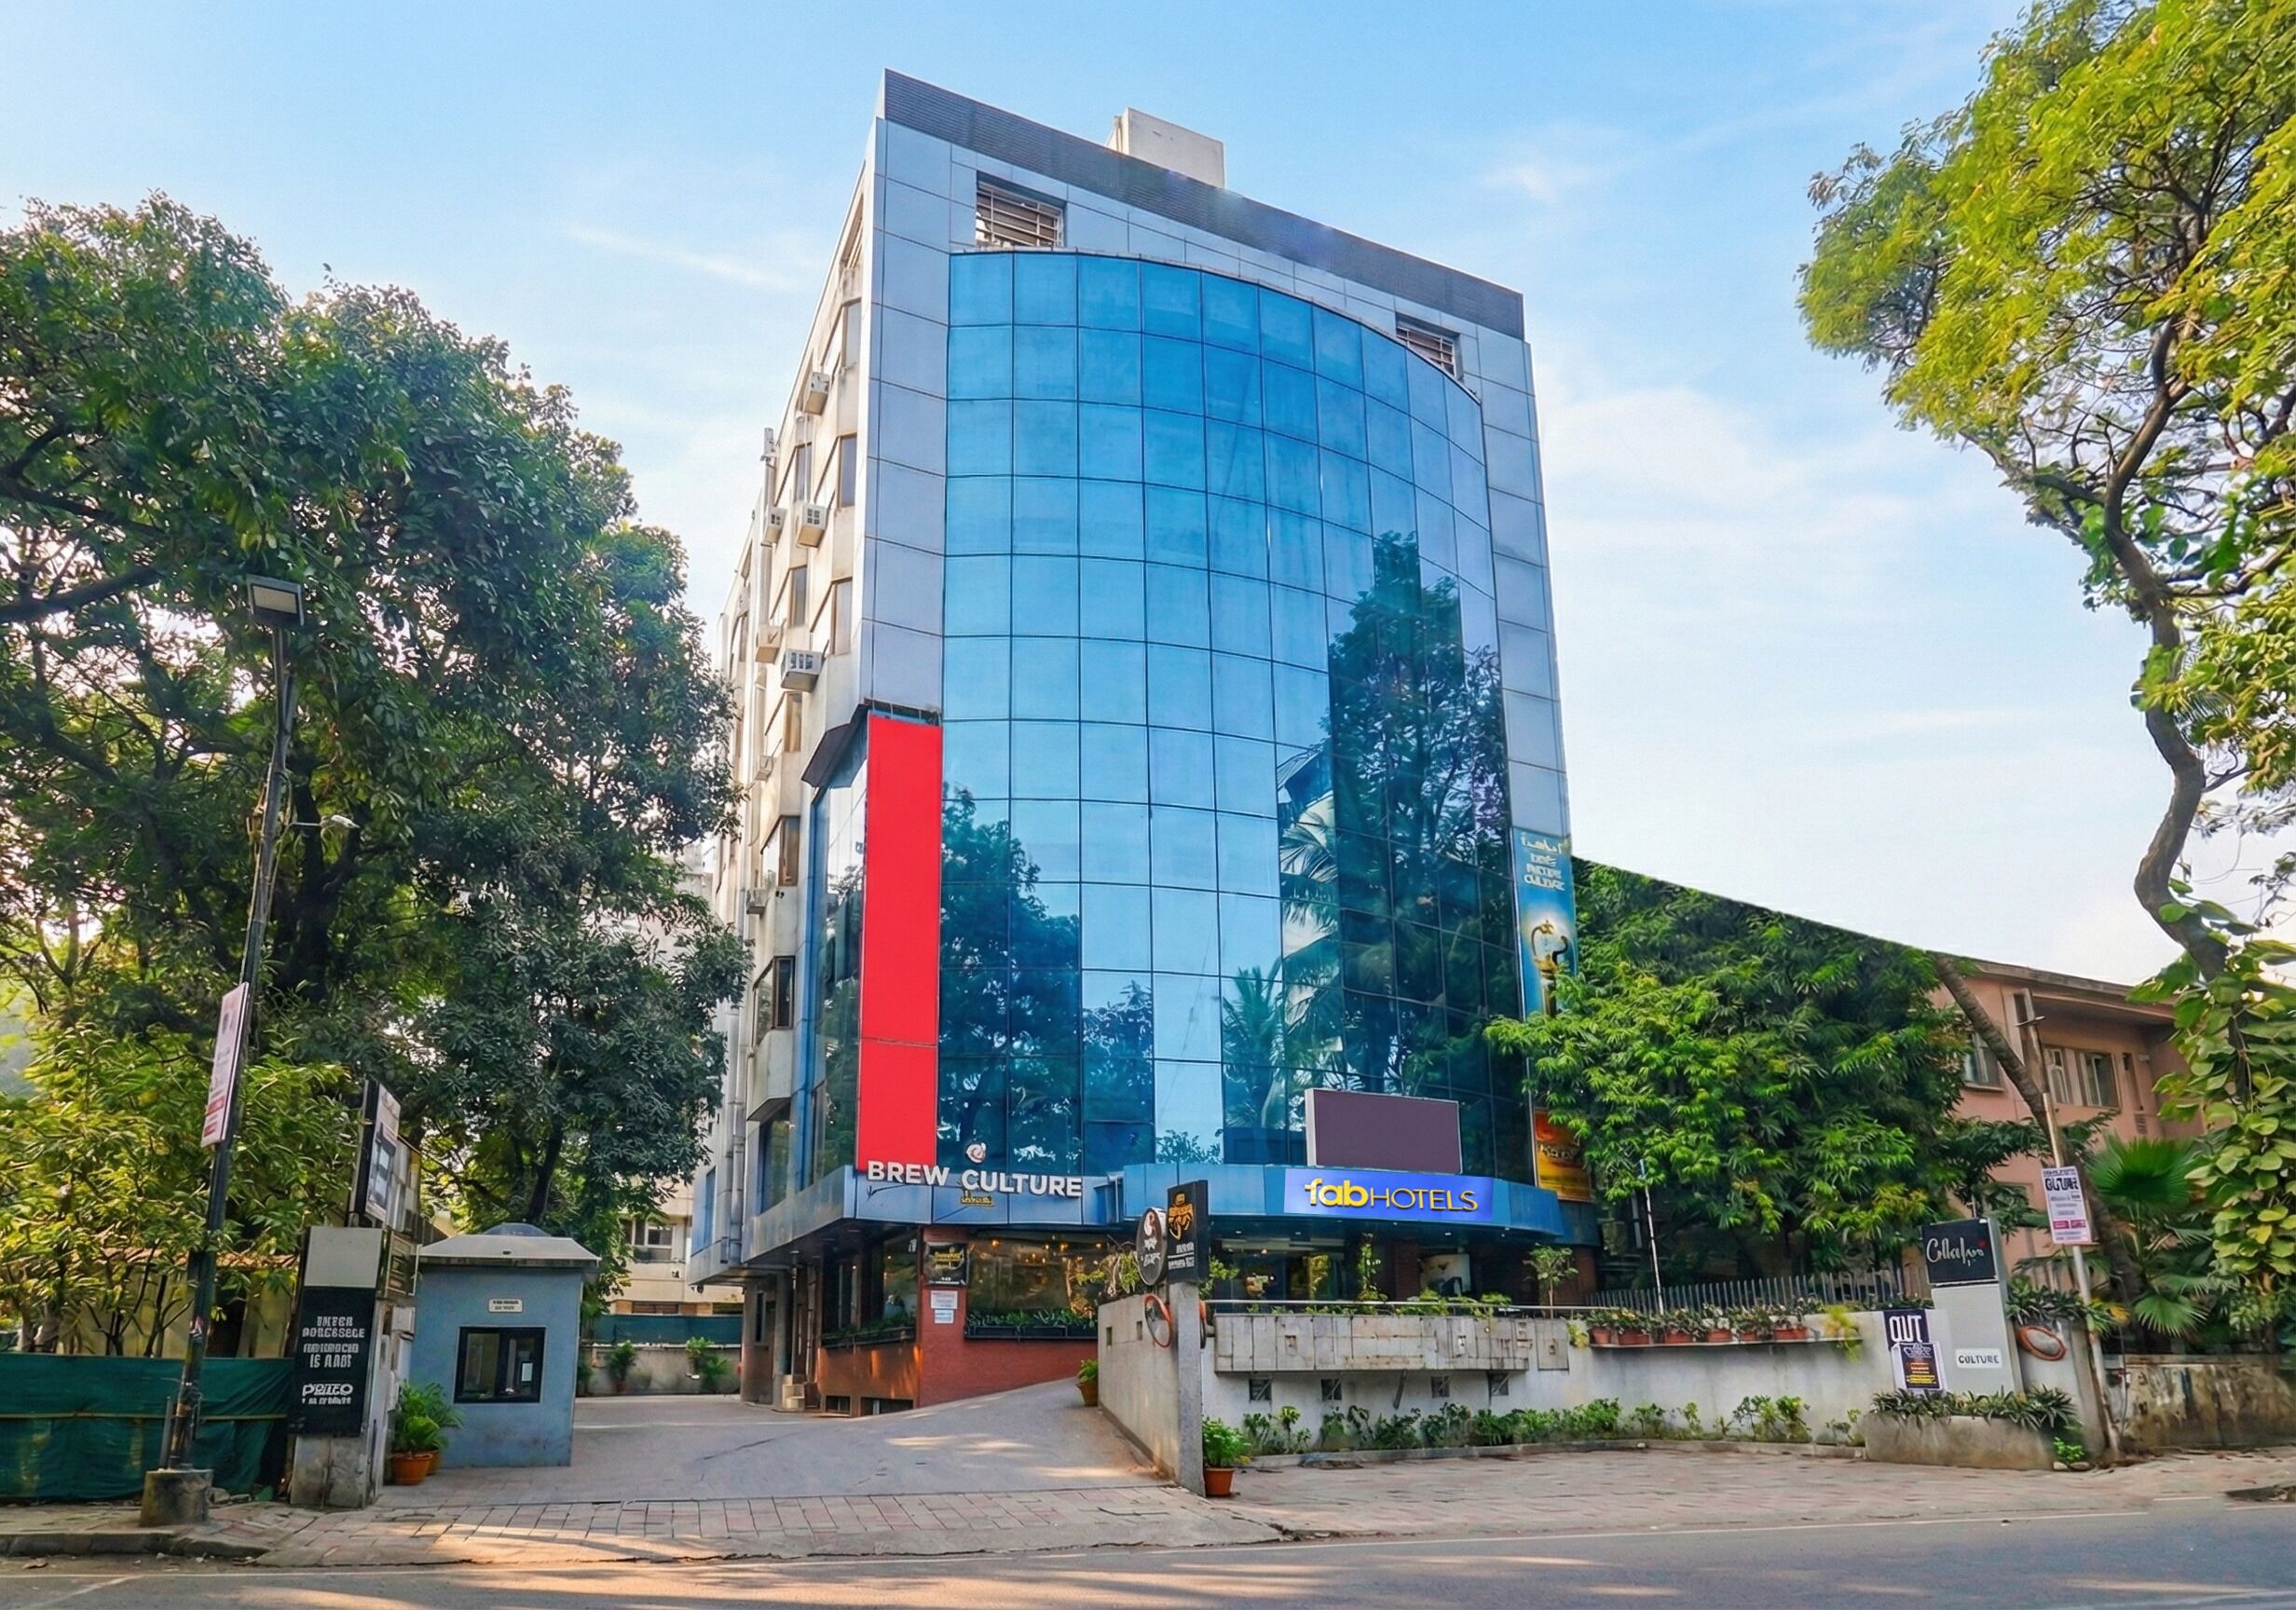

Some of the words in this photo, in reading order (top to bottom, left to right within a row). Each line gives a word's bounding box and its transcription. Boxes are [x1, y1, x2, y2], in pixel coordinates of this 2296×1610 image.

[868, 1160, 950, 1186] BREW
[961, 1168, 1083, 1197] CULTURE
[1958, 1355, 2001, 1365] CULTURE
